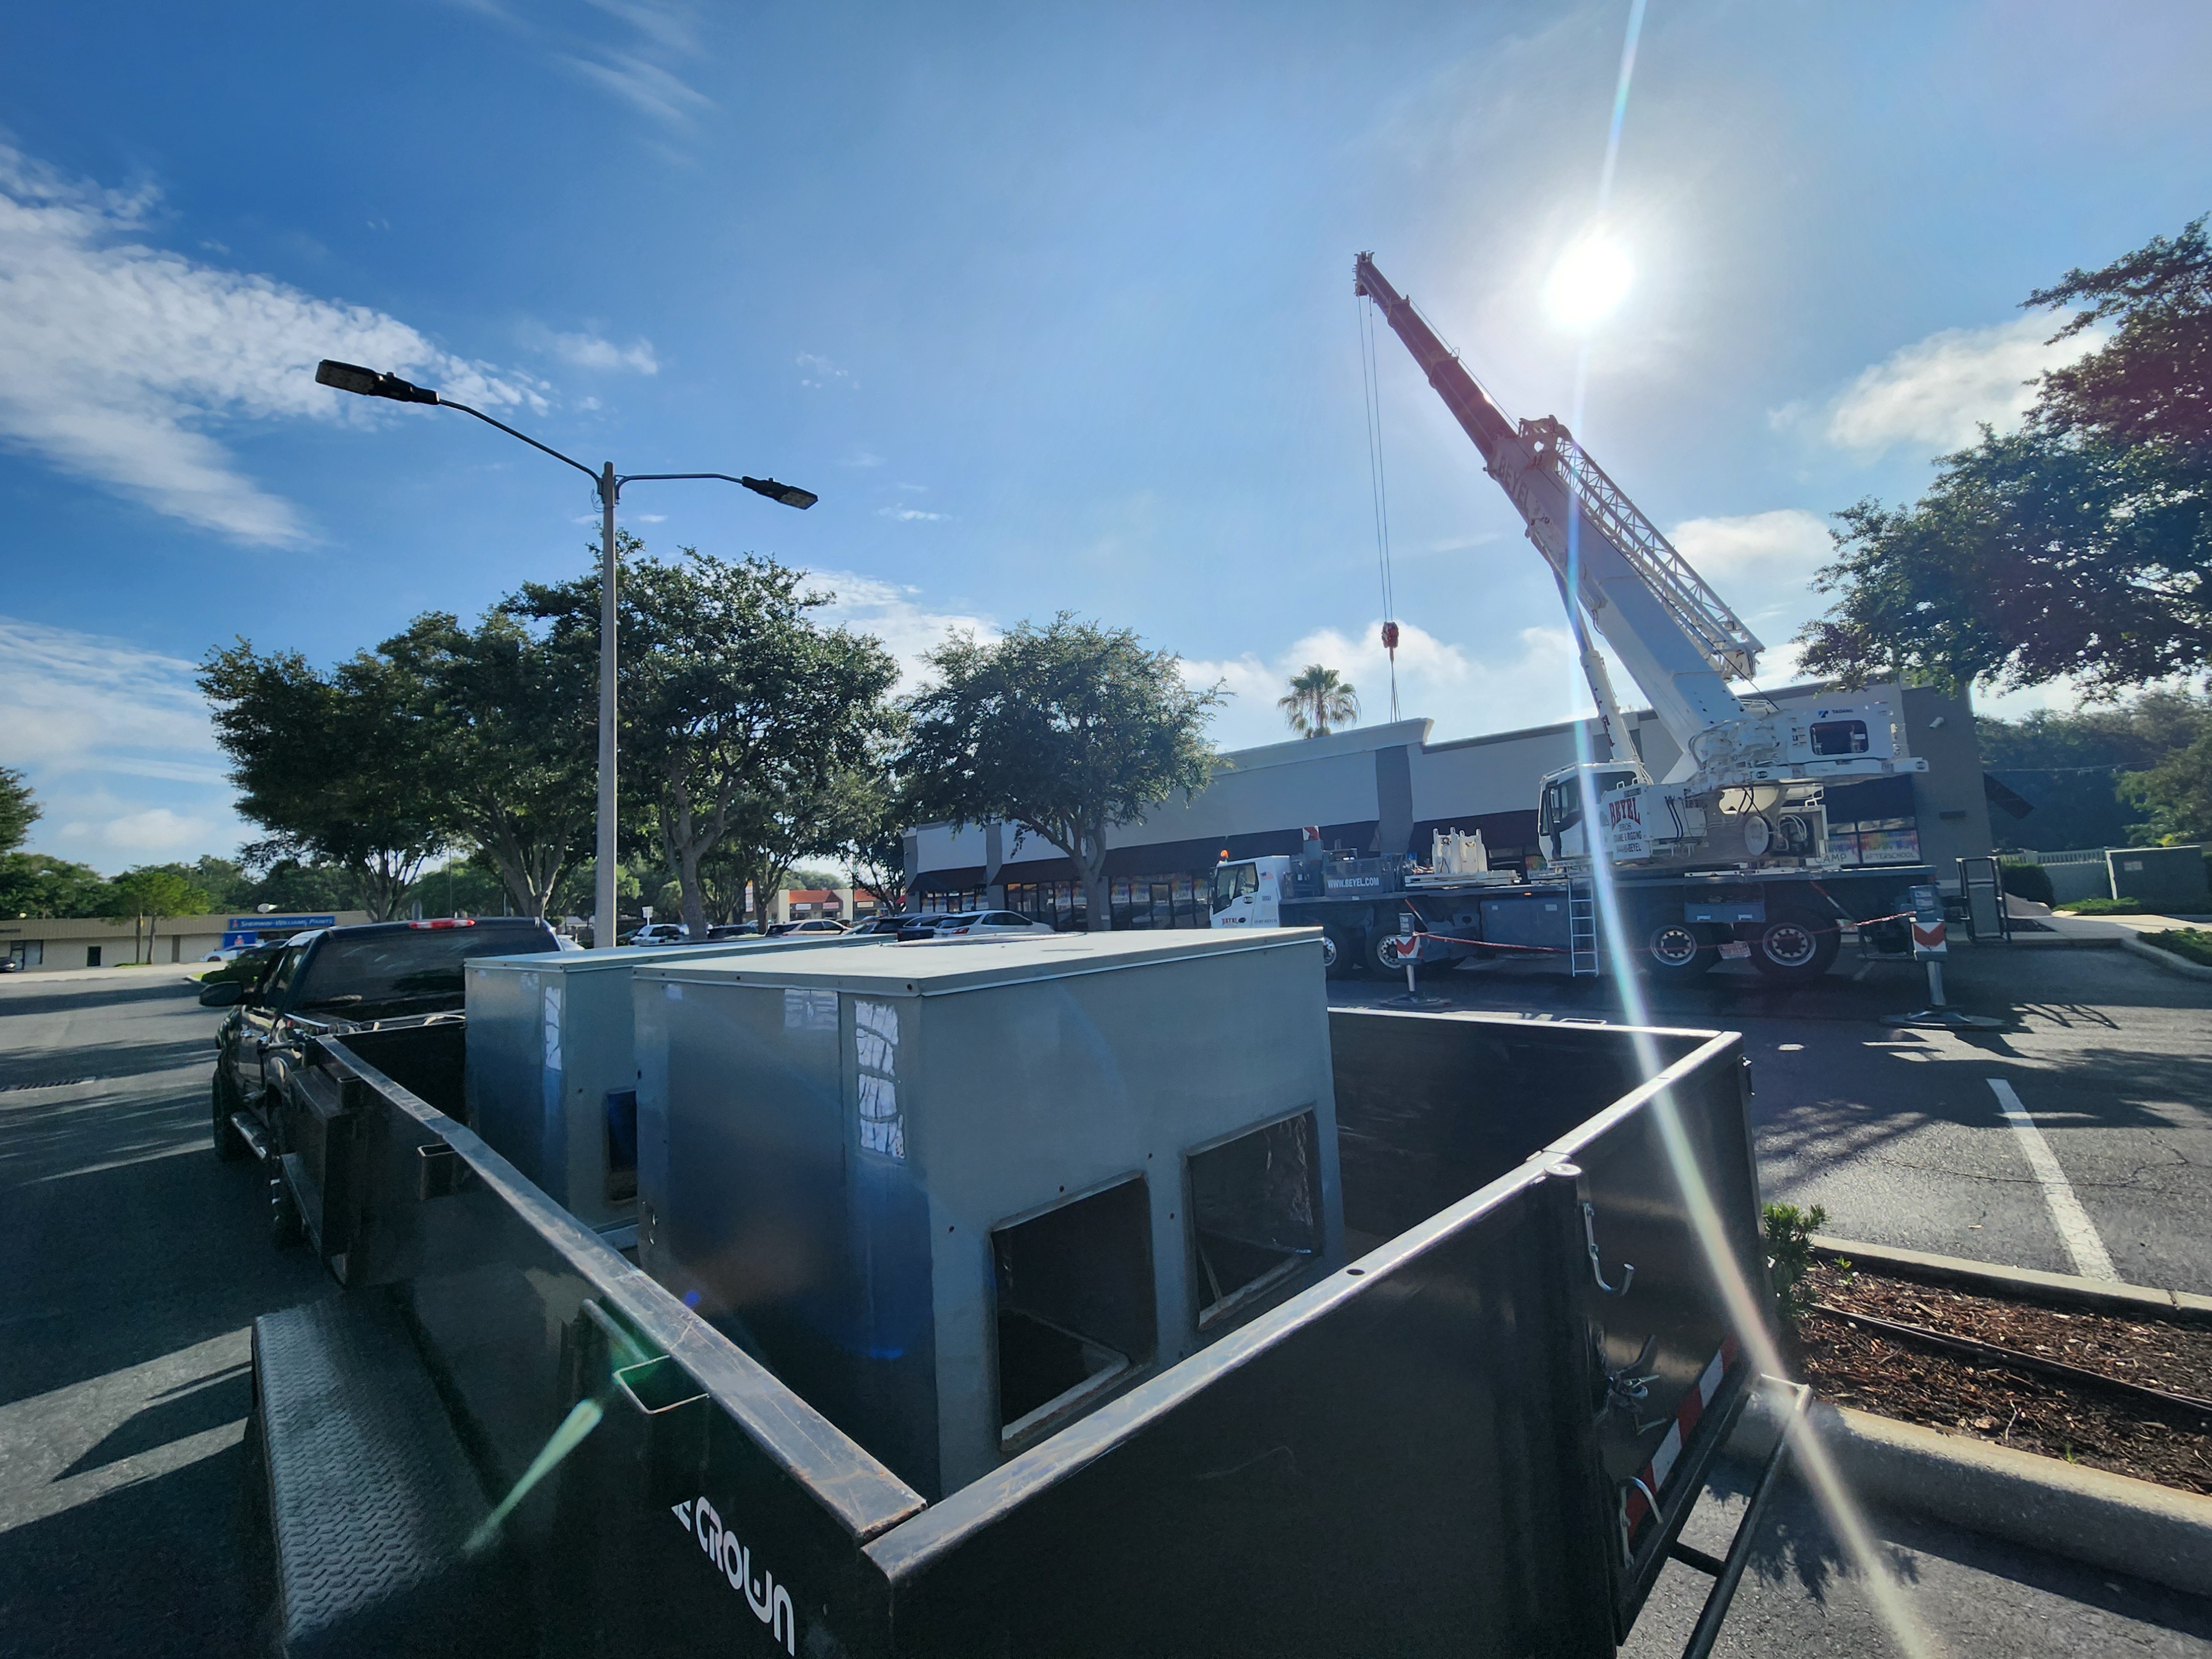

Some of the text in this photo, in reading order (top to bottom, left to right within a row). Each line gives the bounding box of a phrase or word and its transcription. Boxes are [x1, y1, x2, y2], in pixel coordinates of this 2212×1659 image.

[1499, 455, 1530, 515] BEYEL
[1609, 797, 1641, 831] BEYEL
[1865, 851, 1916, 860] AFTERSCHOOL
[1327, 877, 1380, 889] WWW.BEYEL.COM
